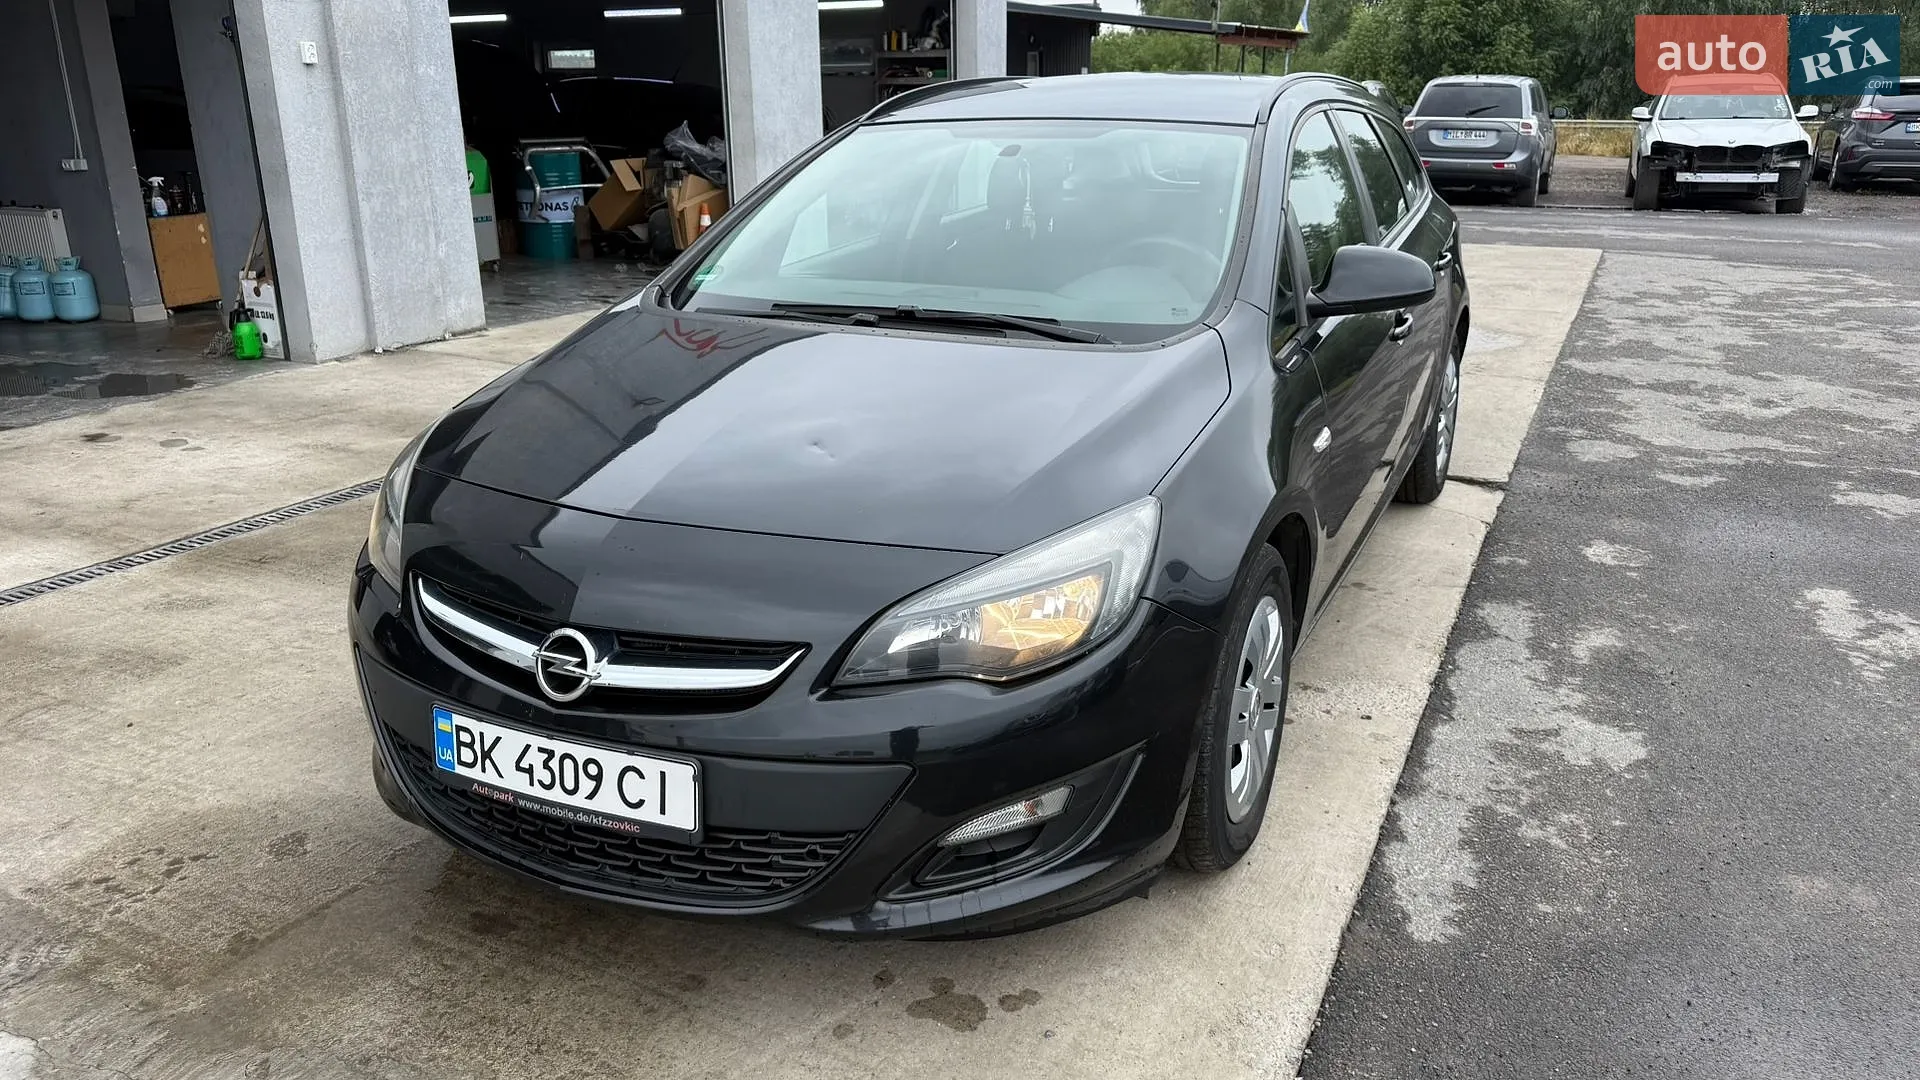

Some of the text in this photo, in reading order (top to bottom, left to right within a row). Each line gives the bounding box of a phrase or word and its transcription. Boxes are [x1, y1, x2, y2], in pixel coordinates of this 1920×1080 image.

[438, 746, 453, 763] UA
[454, 724, 666, 815] BK 4309 CI
[472, 782, 514, 803] Autopark
